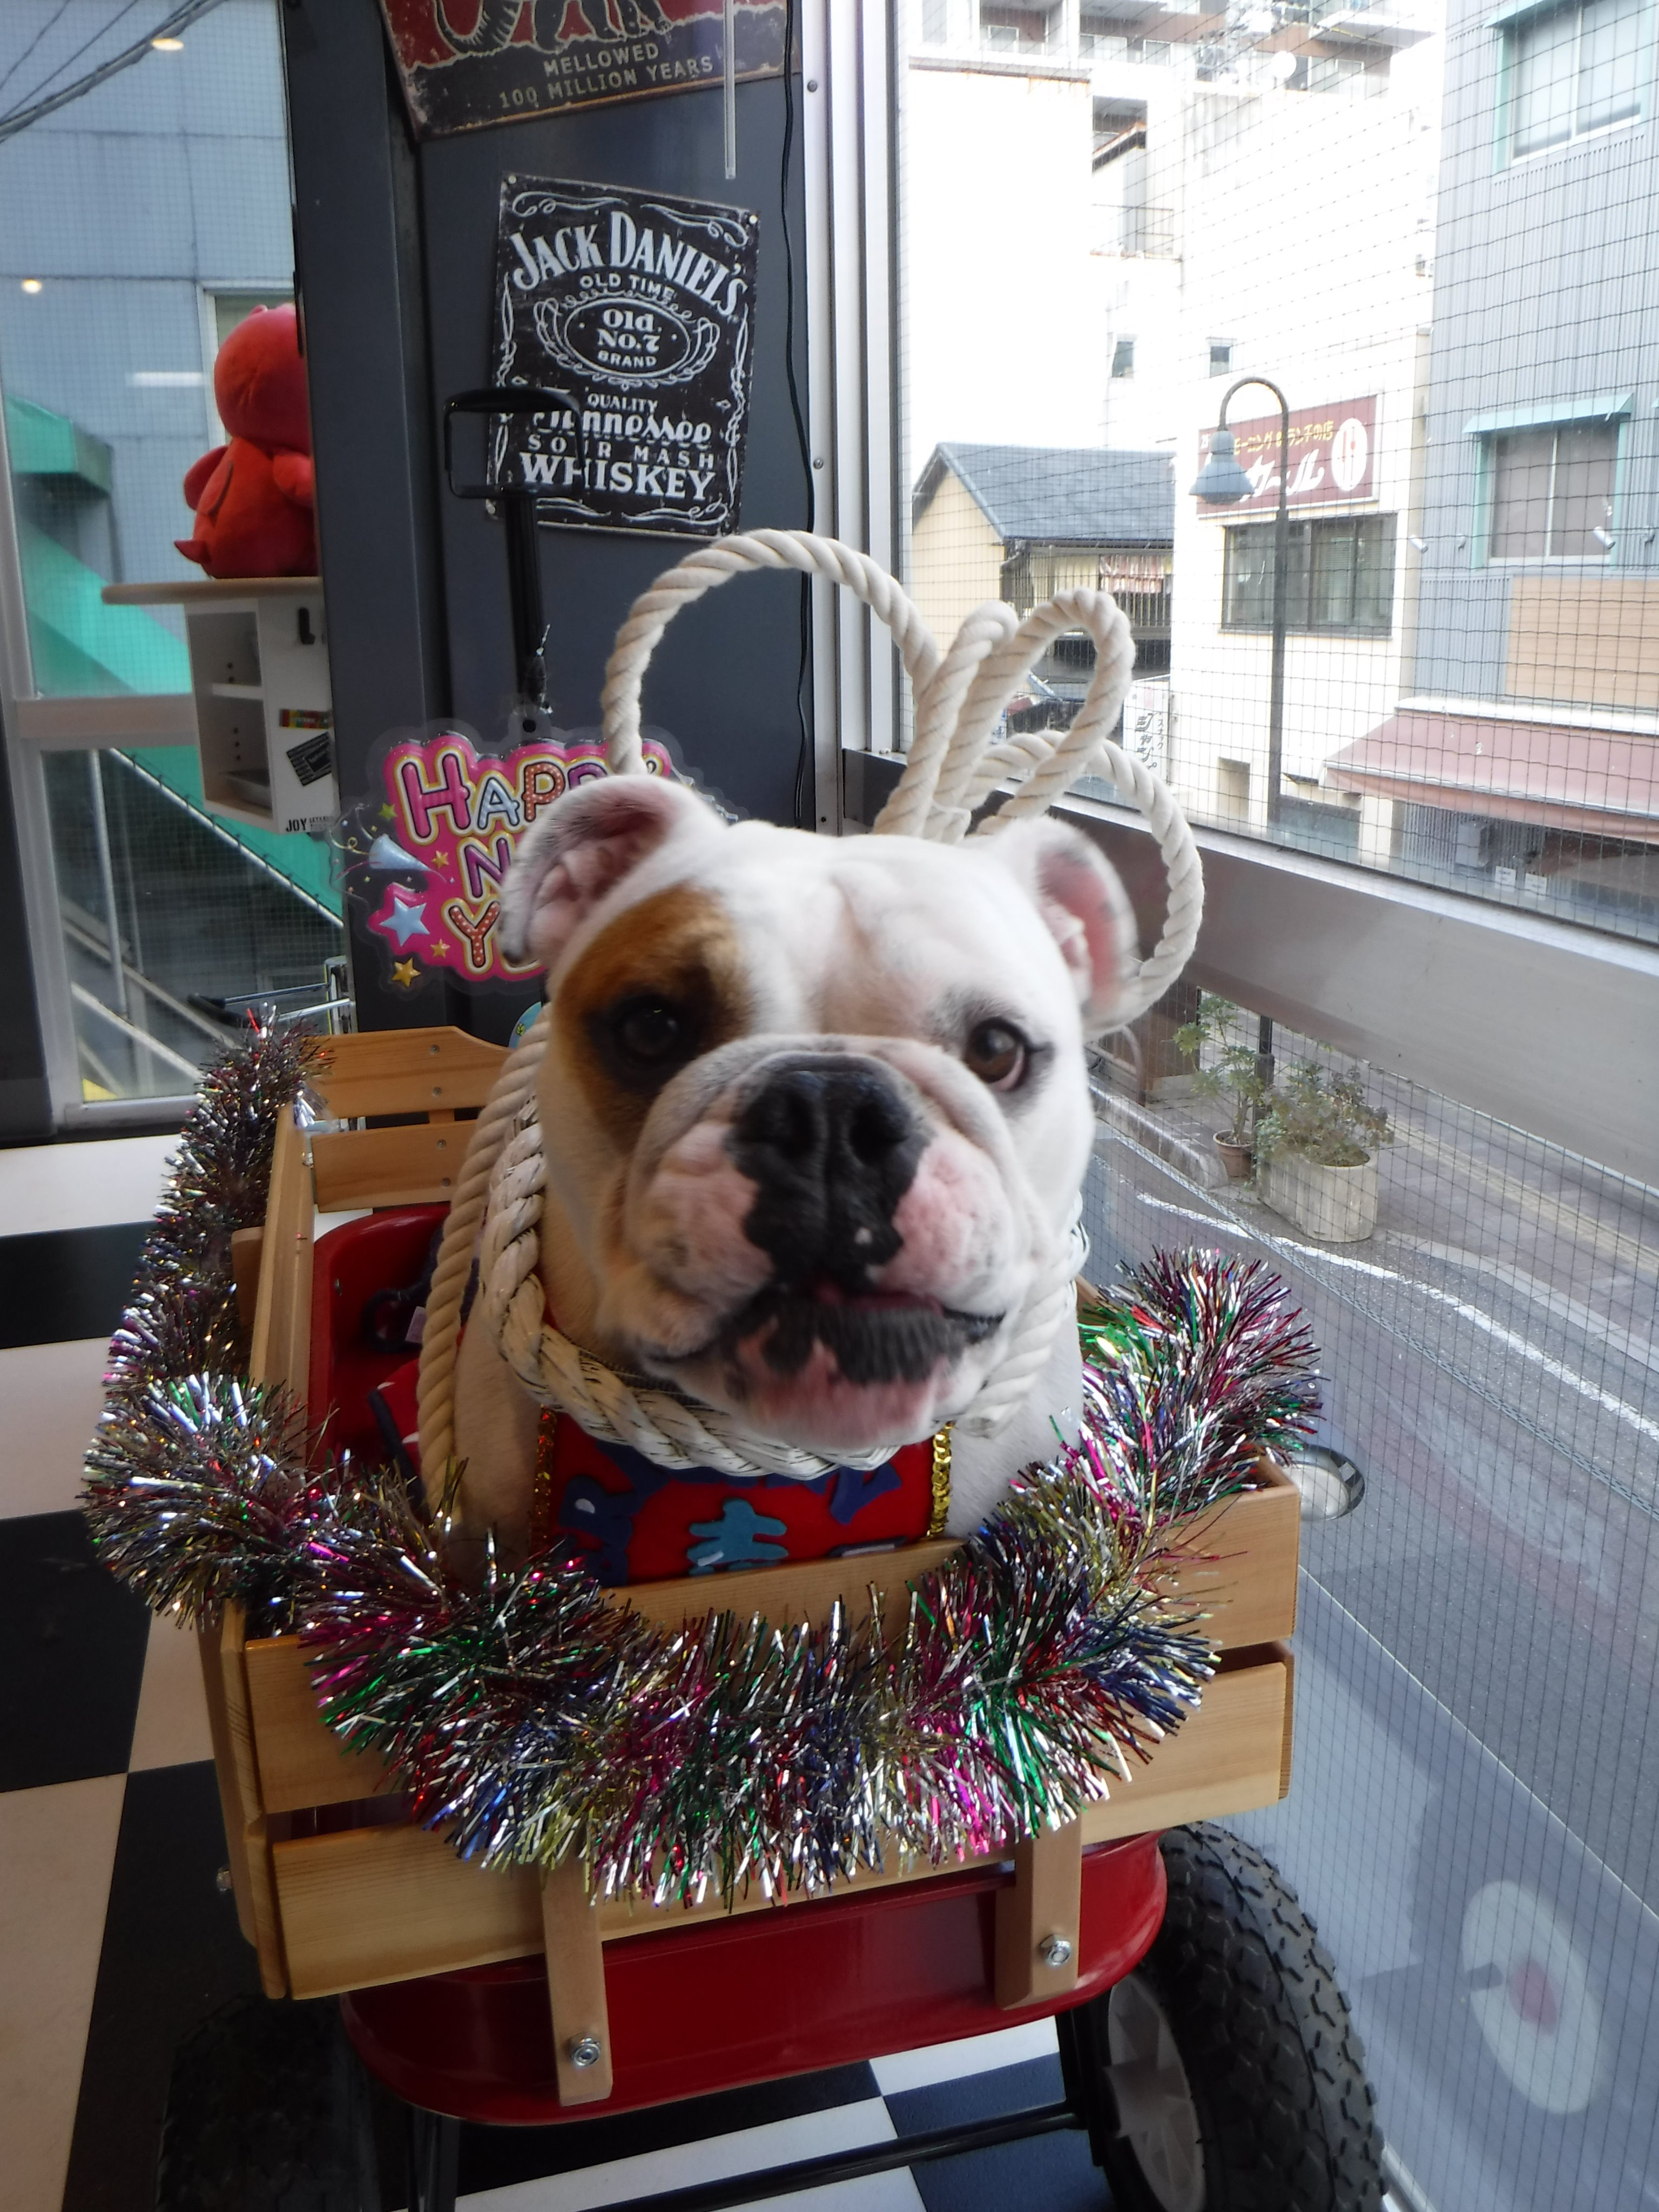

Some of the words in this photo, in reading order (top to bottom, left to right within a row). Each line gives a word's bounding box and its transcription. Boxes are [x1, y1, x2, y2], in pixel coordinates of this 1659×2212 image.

[544, 43, 659, 77] MELLOWED
[500, 87, 538, 108] 100
[548, 69, 638, 100] MILLION
[646, 56, 713, 81] YEARS
[510, 224, 605, 291] JACK
[610, 211, 748, 315] DANIEL'S
[579, 274, 623, 289] OLD
[629, 274, 676, 300] TIME
[603, 308, 655, 332] Old
[598, 350, 657, 368] BRAND
[588, 393, 658, 413] QUALITY
[634, 444, 714, 469] MASH
[520, 450, 716, 501] WHISKEY
[401, 753, 657, 839] HAP
[286, 818, 307, 832] JOY
